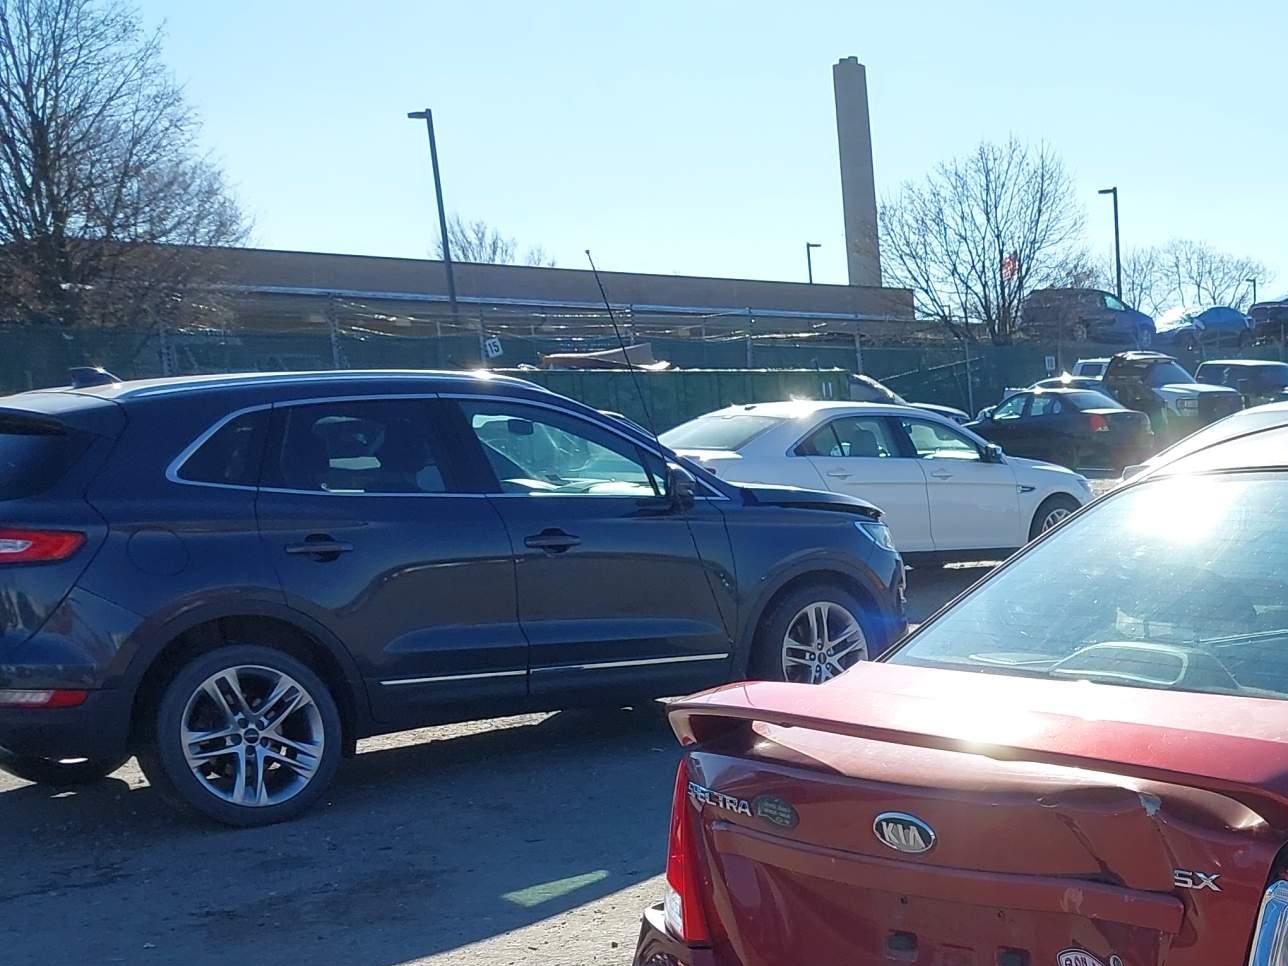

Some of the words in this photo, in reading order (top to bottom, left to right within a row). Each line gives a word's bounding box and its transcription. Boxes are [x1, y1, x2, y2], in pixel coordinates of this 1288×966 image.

[488, 341, 500, 353] 15
[881, 821, 926, 848] KIA
[1174, 869, 1222, 892] SX
